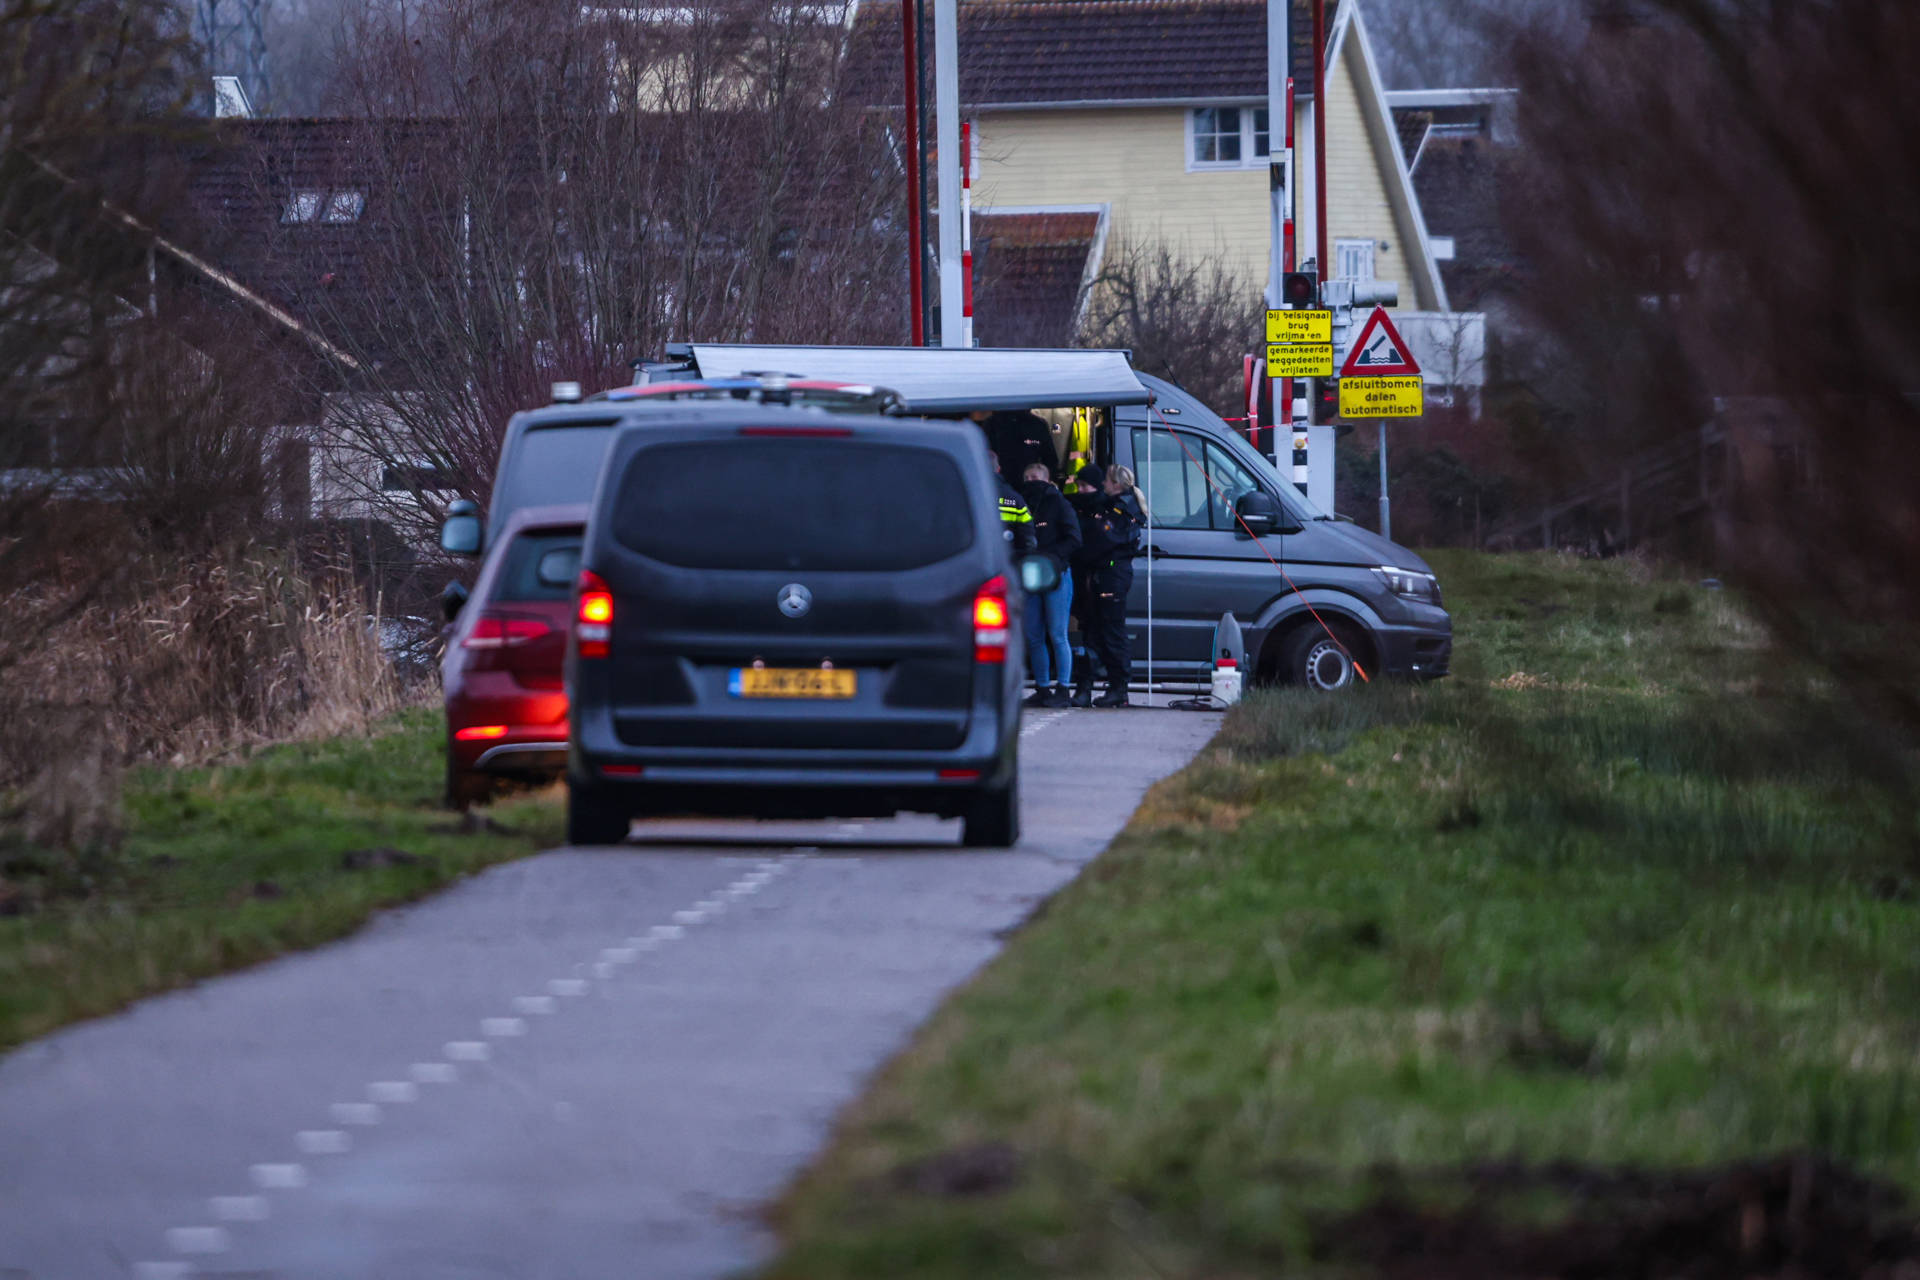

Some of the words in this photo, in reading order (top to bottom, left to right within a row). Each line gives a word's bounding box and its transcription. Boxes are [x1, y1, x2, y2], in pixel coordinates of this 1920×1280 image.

[1268, 312, 1279, 321] bij
[1288, 322, 1309, 331] brug
[1276, 331, 1321, 341] vrijmaen
[1270, 346, 1329, 355] gemarkeerde
[1269, 356, 1330, 365] weggedeelten
[1280, 366, 1319, 375] vrijlaten
[1342, 379, 1419, 389] afsluitbomen
[1365, 392, 1396, 401] dalen
[1344, 404, 1417, 414] automatisch
